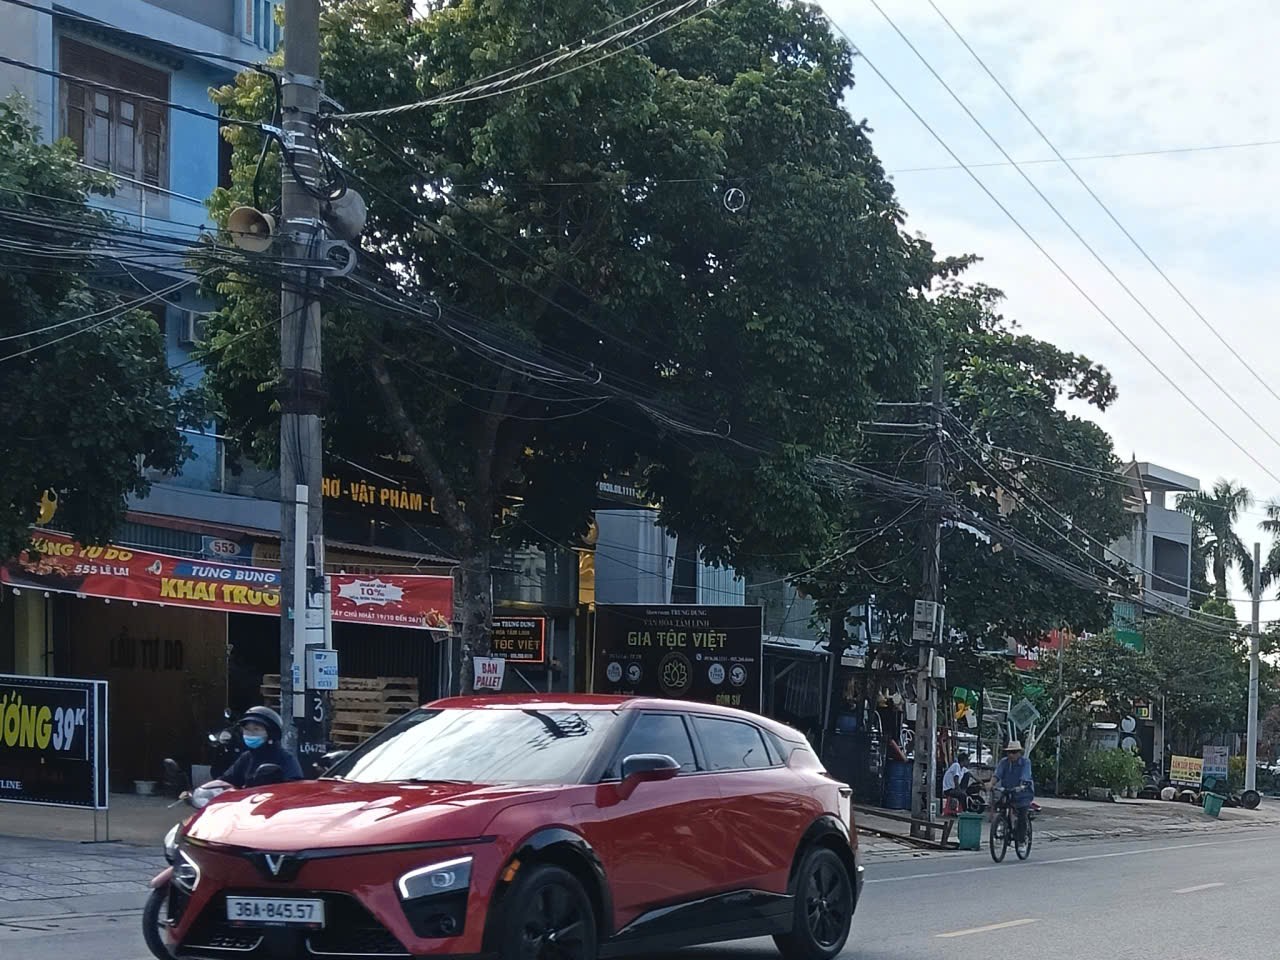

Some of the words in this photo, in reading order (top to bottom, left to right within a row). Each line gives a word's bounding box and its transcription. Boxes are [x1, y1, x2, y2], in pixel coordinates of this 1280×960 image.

[350, 480, 376, 507] VẬT
[213, 541, 236, 554] 553
[74, 564, 98, 574] 555
[100, 564, 112, 575] LÊ
[113, 566, 129, 576] LAI
[160, 577, 218, 602] KHAI
[360, 587, 385, 597] 10%
[627, 631, 652, 646] GIA
[656, 628, 687, 650] TỘC
[692, 630, 727, 651] VIỆT
[481, 660, 498, 675] BÁN
[475, 676, 501, 687] PALLET
